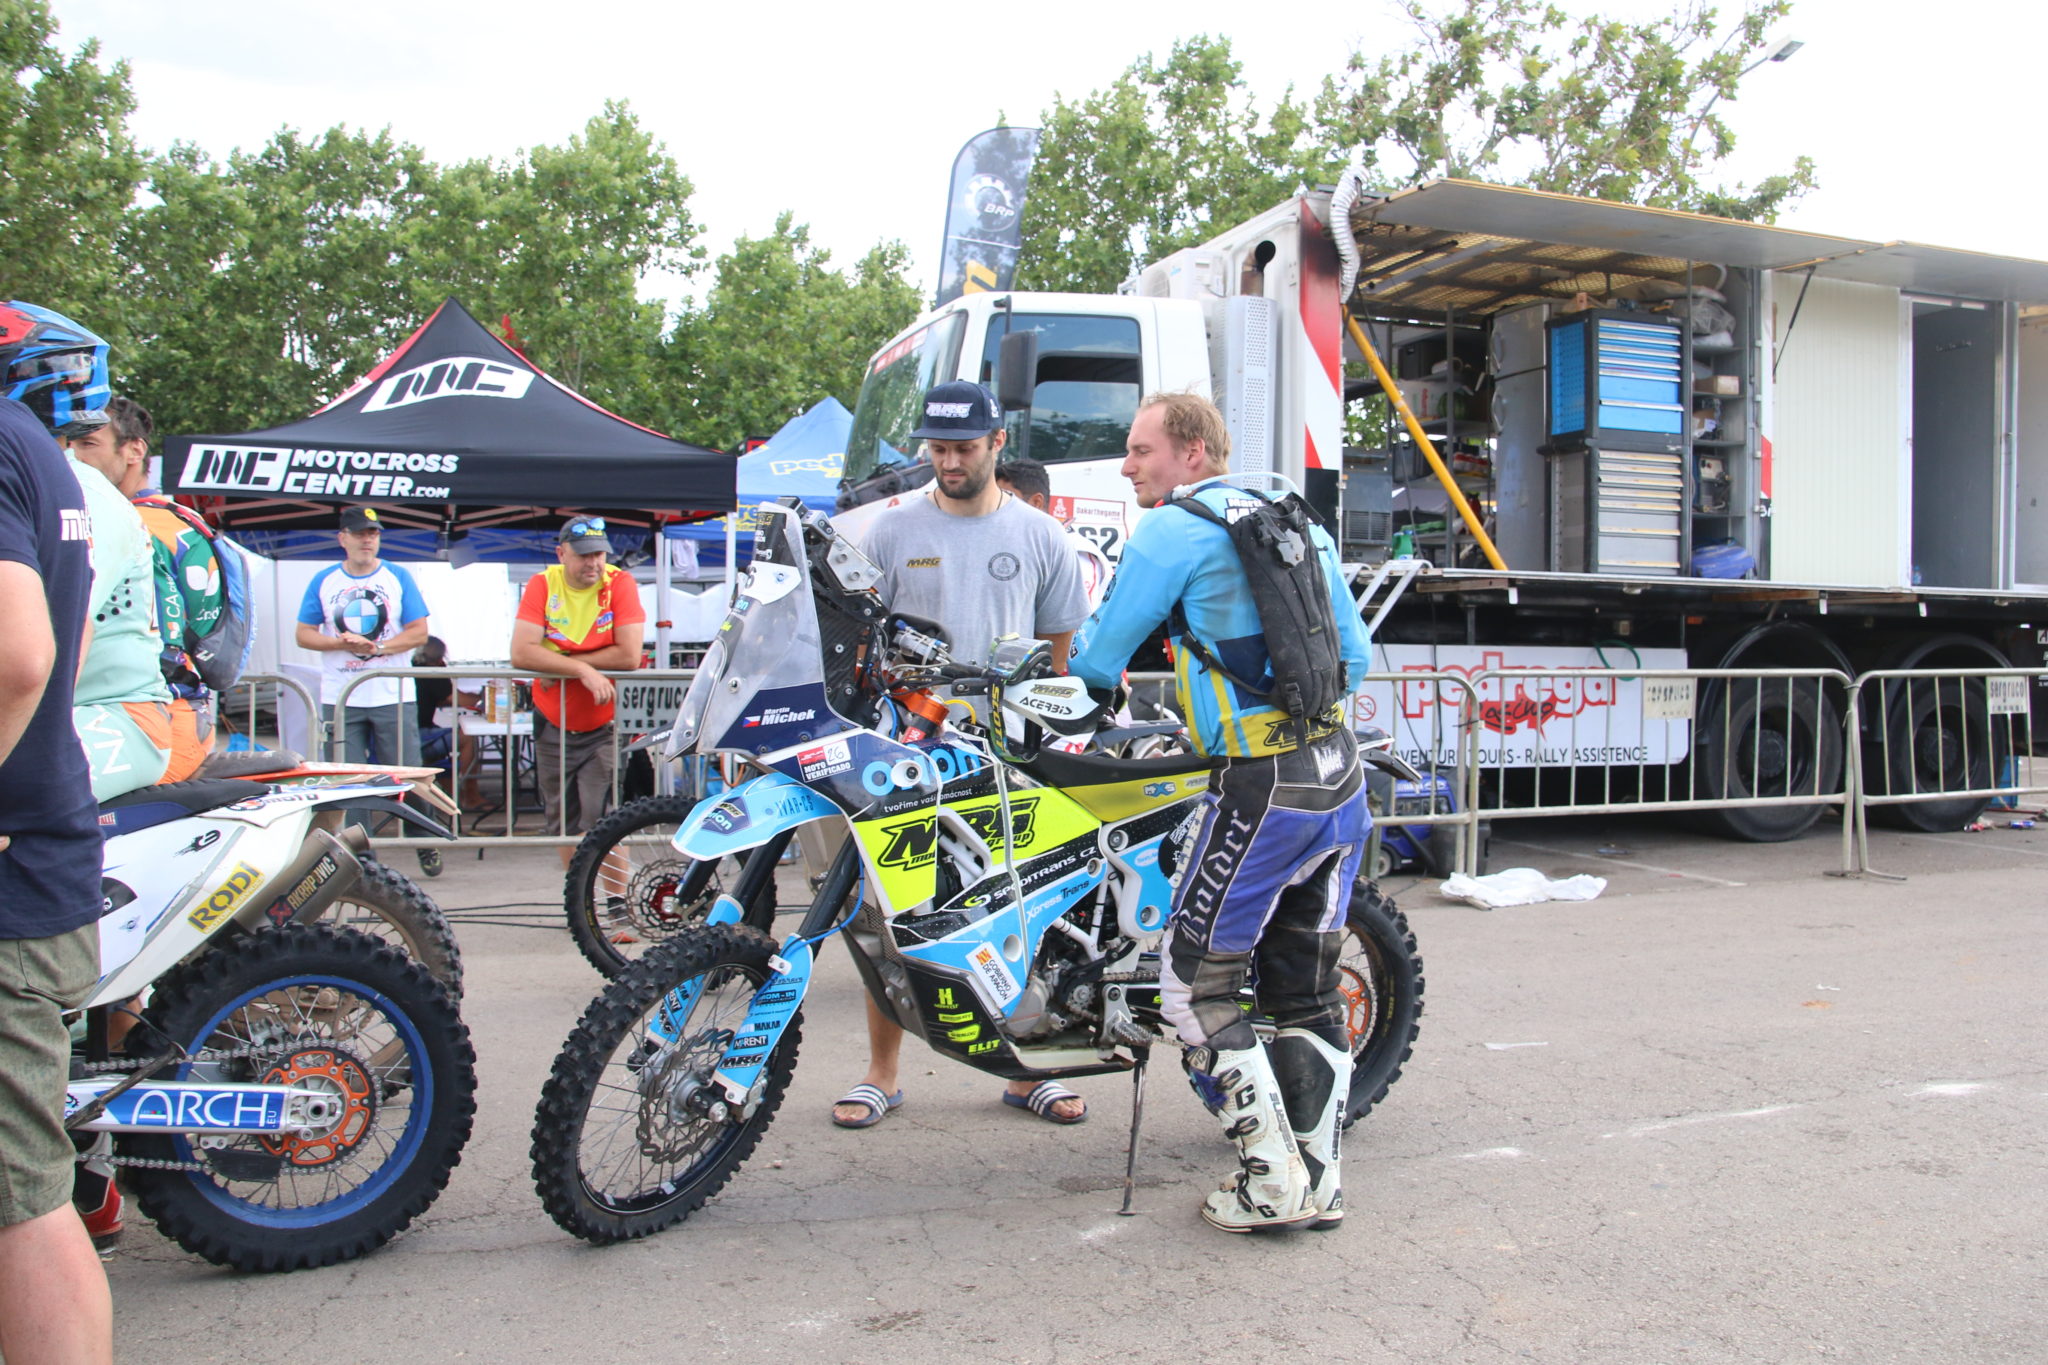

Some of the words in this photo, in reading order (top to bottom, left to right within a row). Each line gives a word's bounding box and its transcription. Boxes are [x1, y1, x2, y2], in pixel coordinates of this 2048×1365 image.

[984, 203, 1015, 217] BRP
[291, 449, 460, 474] MOTOCROSS
[906, 558, 942, 569] MRG
[760, 709, 816, 726] Michek
[827, 746, 845, 762] 26
[1574, 746, 1648, 762] ASSISTENCE
[804, 761, 826, 774] MOTO
[805, 762, 851, 780] VERIFICADO
[987, 833, 1030, 846] grup
[188, 862, 260, 929] RODI
[982, 964, 992, 974] DE
[989, 959, 1012, 991] GOBIERNO
[968, 1039, 1000, 1053] ELIT
[131, 1090, 269, 1127] ARCH
